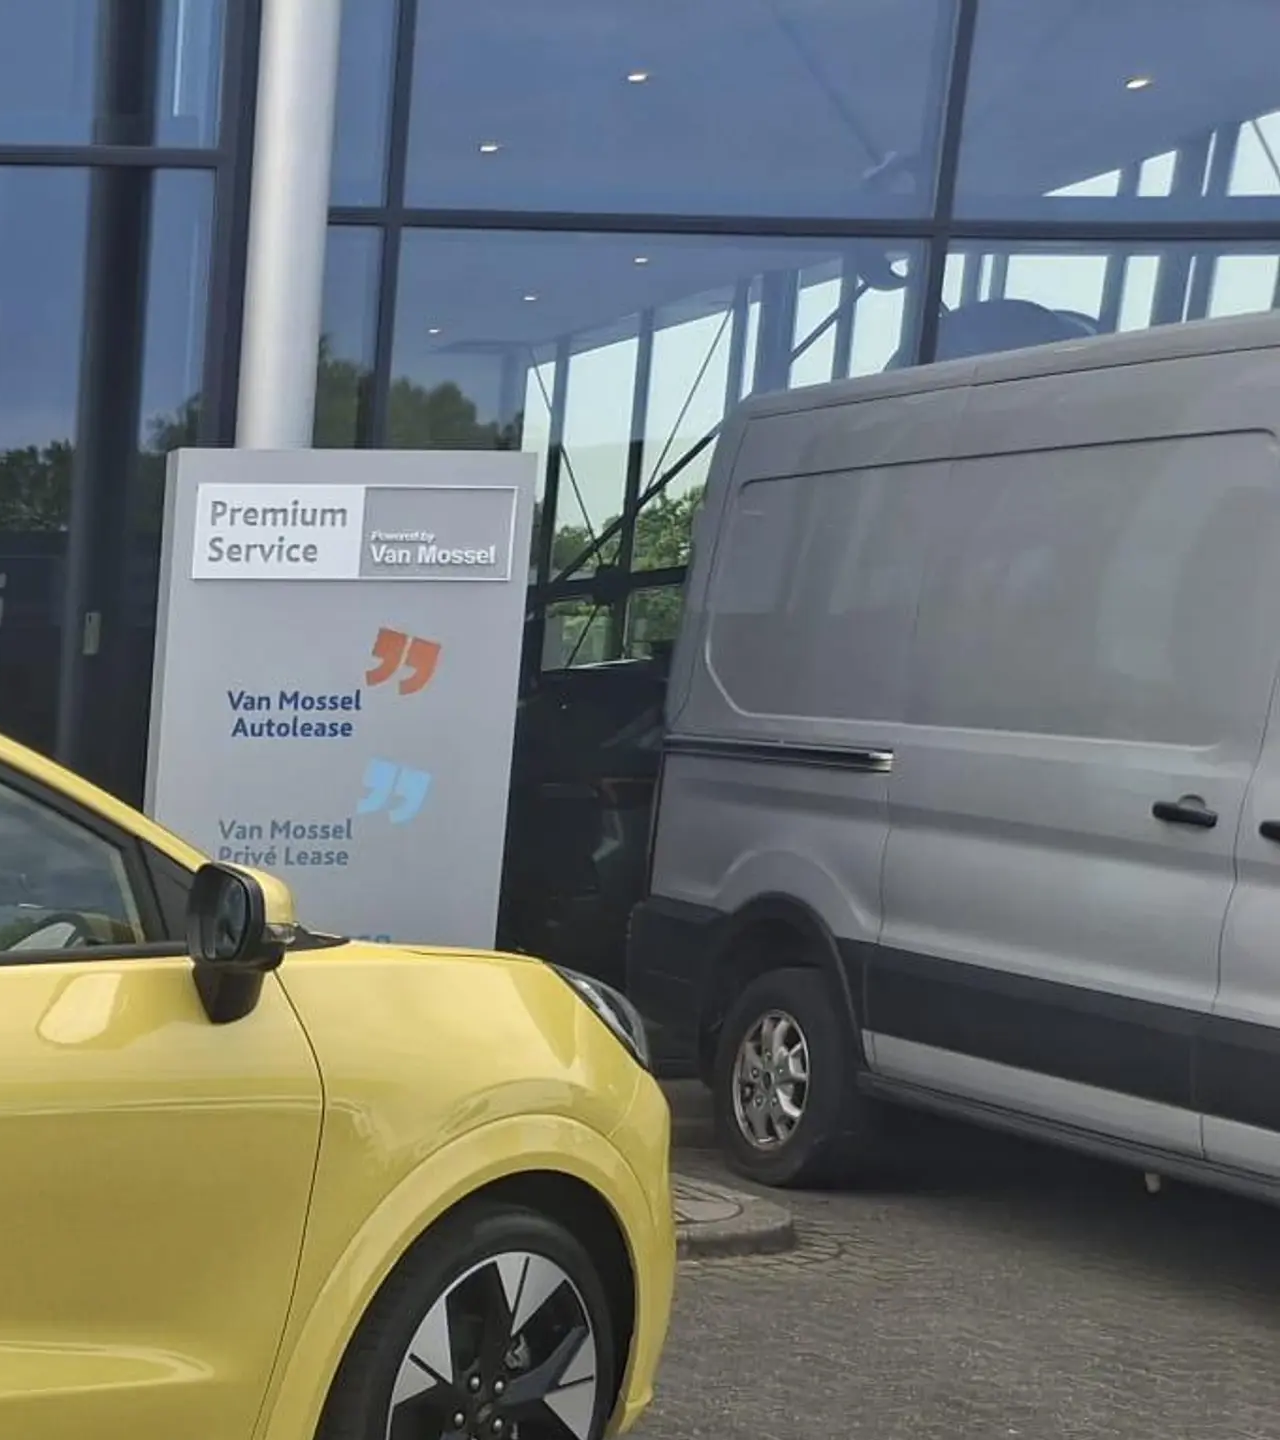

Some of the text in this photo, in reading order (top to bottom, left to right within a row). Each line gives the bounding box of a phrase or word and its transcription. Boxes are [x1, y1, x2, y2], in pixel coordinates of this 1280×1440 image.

[210, 500, 348, 527] Premium
[207, 536, 318, 564] Service
[370, 544, 496, 564] Van Mossel
[227, 689, 362, 712] Van Mossel
[231, 715, 353, 738] Autolease
[219, 818, 353, 840] Van Mossel
[218, 846, 349, 866] Privé Lease
